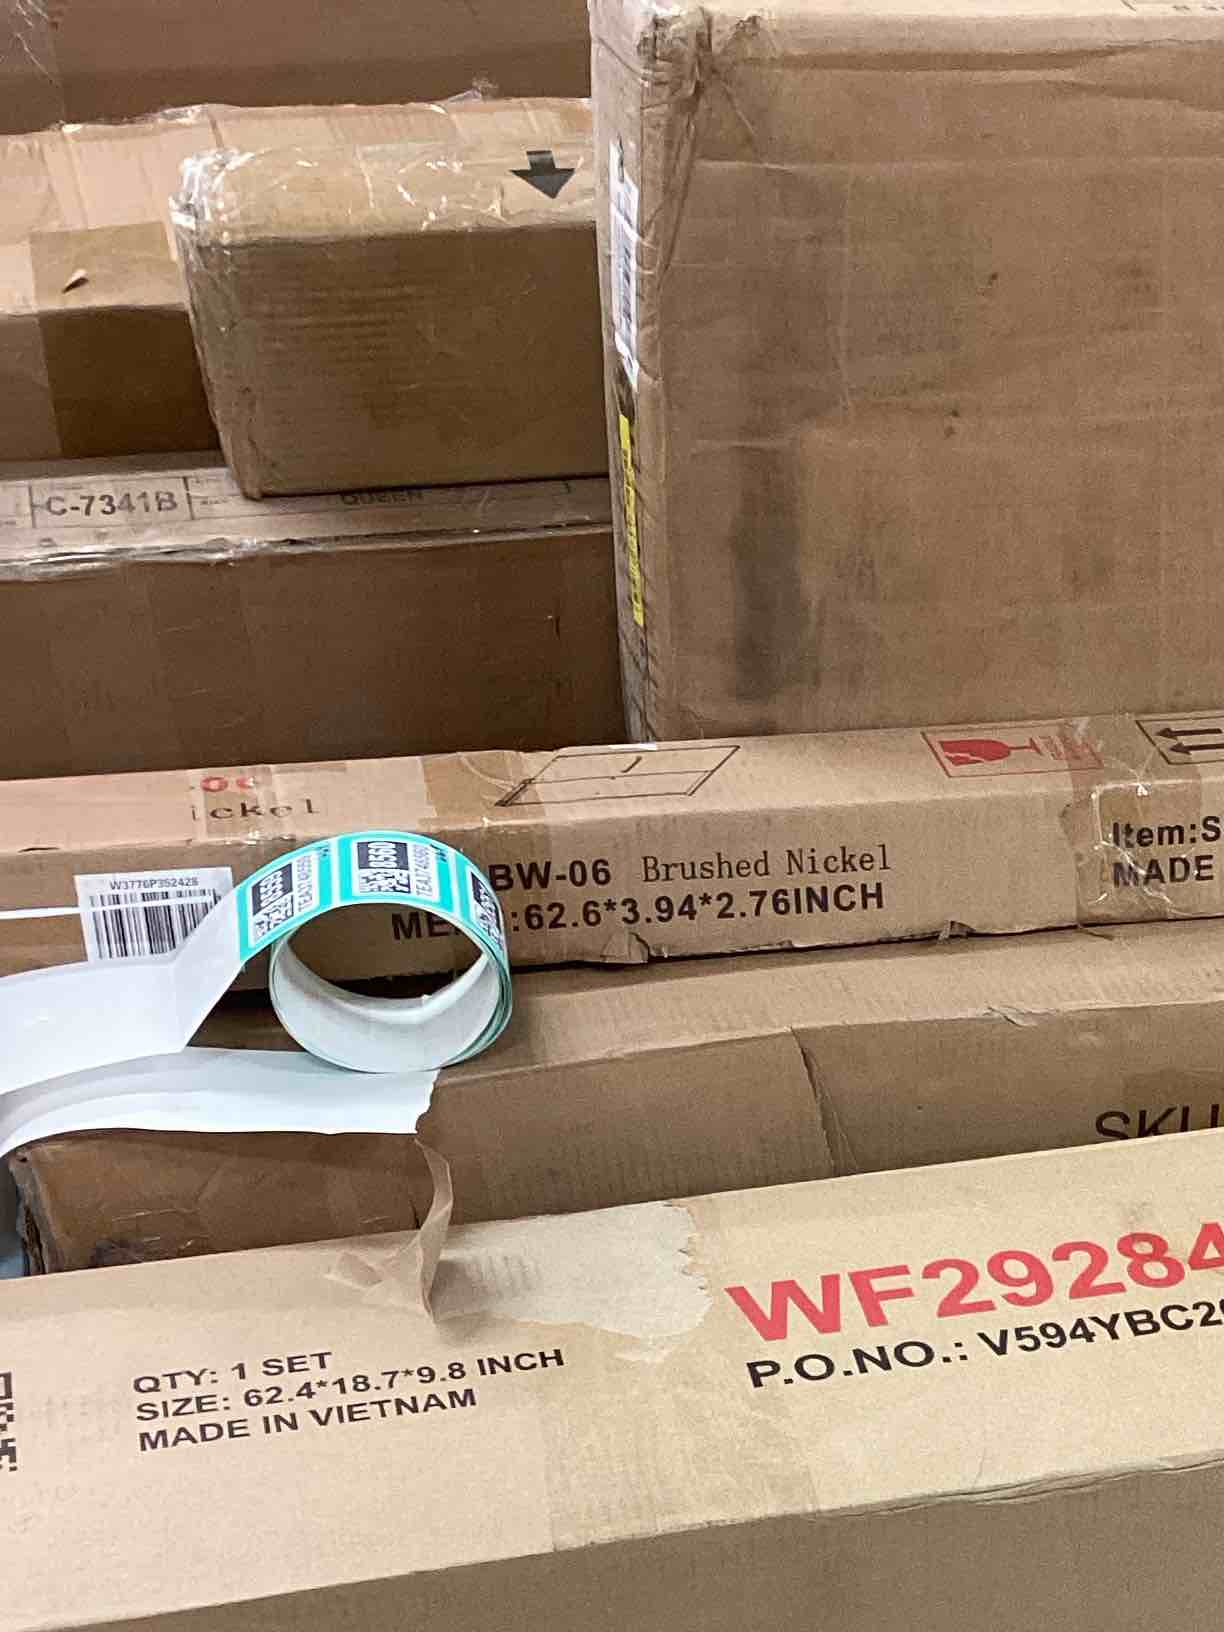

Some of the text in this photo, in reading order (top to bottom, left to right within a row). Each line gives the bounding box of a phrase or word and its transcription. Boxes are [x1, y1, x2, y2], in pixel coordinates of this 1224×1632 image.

[46, 491, 178, 517] C-7341B
[642, 849, 770, 884] Brushed
[786, 843, 892, 877] Nickel
[1112, 854, 1214, 888] MADE
[391, 881, 885, 941] ME:62.63.942.76INCH
[132, 1351, 333, 1394] QTY: 1 SET
[135, 1393, 231, 1423] SIZE:
[476, 1347, 566, 1378] INCH
[745, 1336, 969, 1388] P.O.NO.:
[138, 1387, 479, 1453] MADE IN VIETNAM
